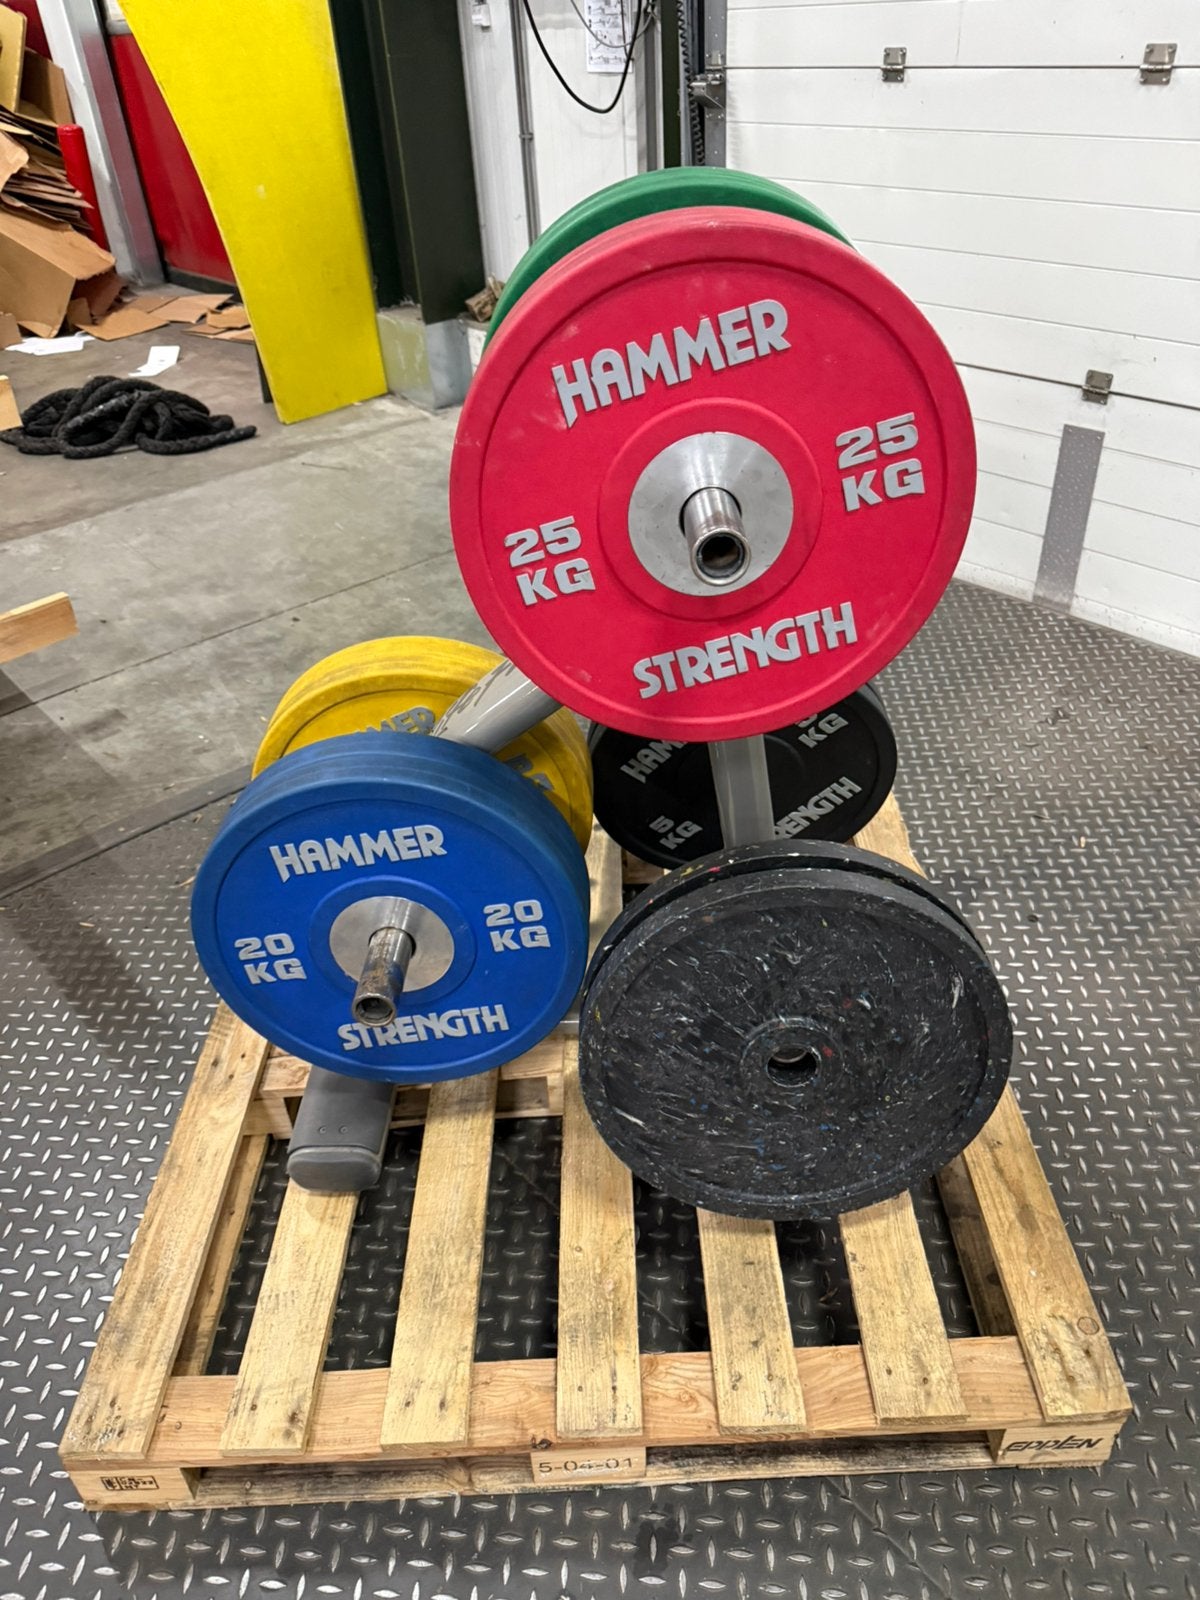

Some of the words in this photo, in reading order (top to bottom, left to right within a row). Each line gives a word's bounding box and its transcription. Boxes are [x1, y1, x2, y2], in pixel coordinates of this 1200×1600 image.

[551, 299, 792, 428] HAMMER
[835, 412, 920, 470] 25
[841, 457, 926, 512] KG
[504, 516, 583, 568] 25
[516, 557, 597, 606] KG
[633, 601, 859, 699] STRENGTH
[798, 712, 849, 749] KG
[620, 739, 688, 784] HAM
[649, 815, 675, 833] 5
[659, 820, 703, 850] KG
[268, 824, 448, 882] HAMMER
[483, 899, 544, 928] 20
[234, 932, 295, 961] 20
[491, 924, 551, 953] KG
[244, 957, 307, 985] KG
[337, 1004, 510, 1051] STRENGTH
[538, 1458, 632, 1473] 5-04-01
